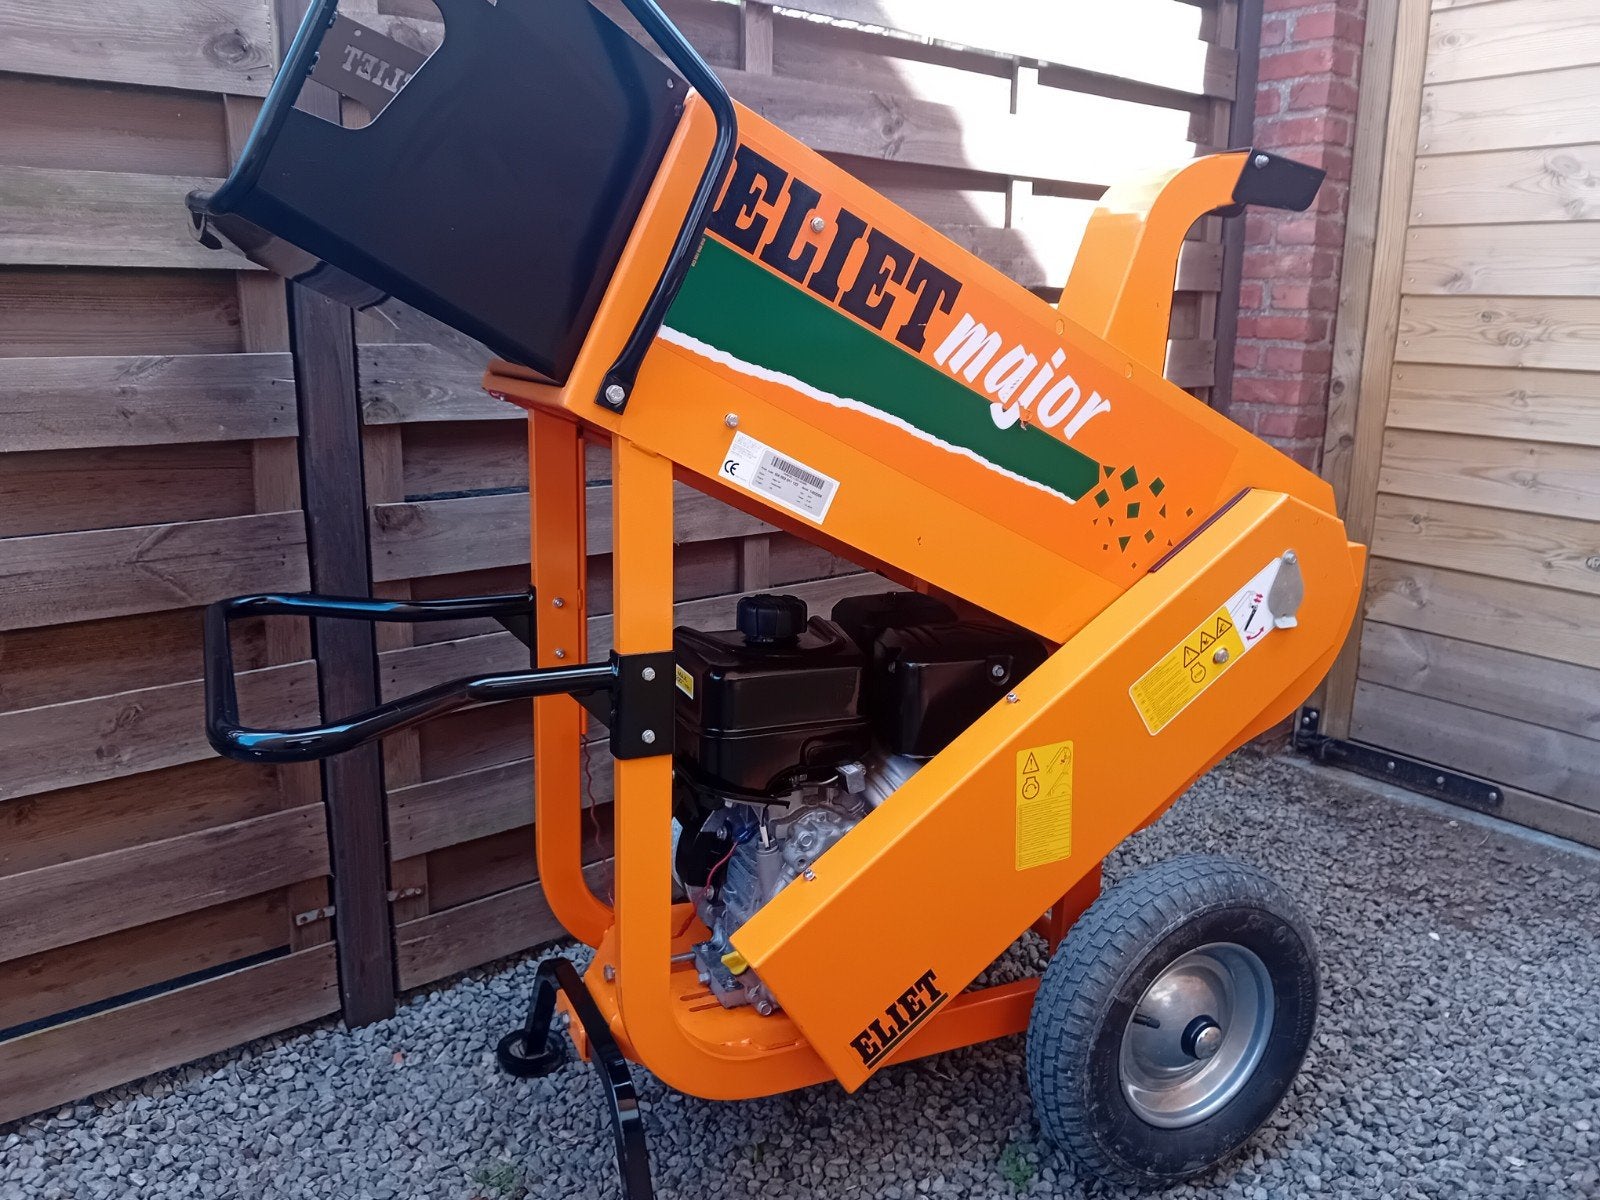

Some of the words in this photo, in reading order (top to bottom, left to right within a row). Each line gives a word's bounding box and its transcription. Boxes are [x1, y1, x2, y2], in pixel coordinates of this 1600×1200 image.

[706, 144, 962, 353] ELIET
[933, 312, 1110, 440] major
[849, 968, 942, 1064] ELIET
